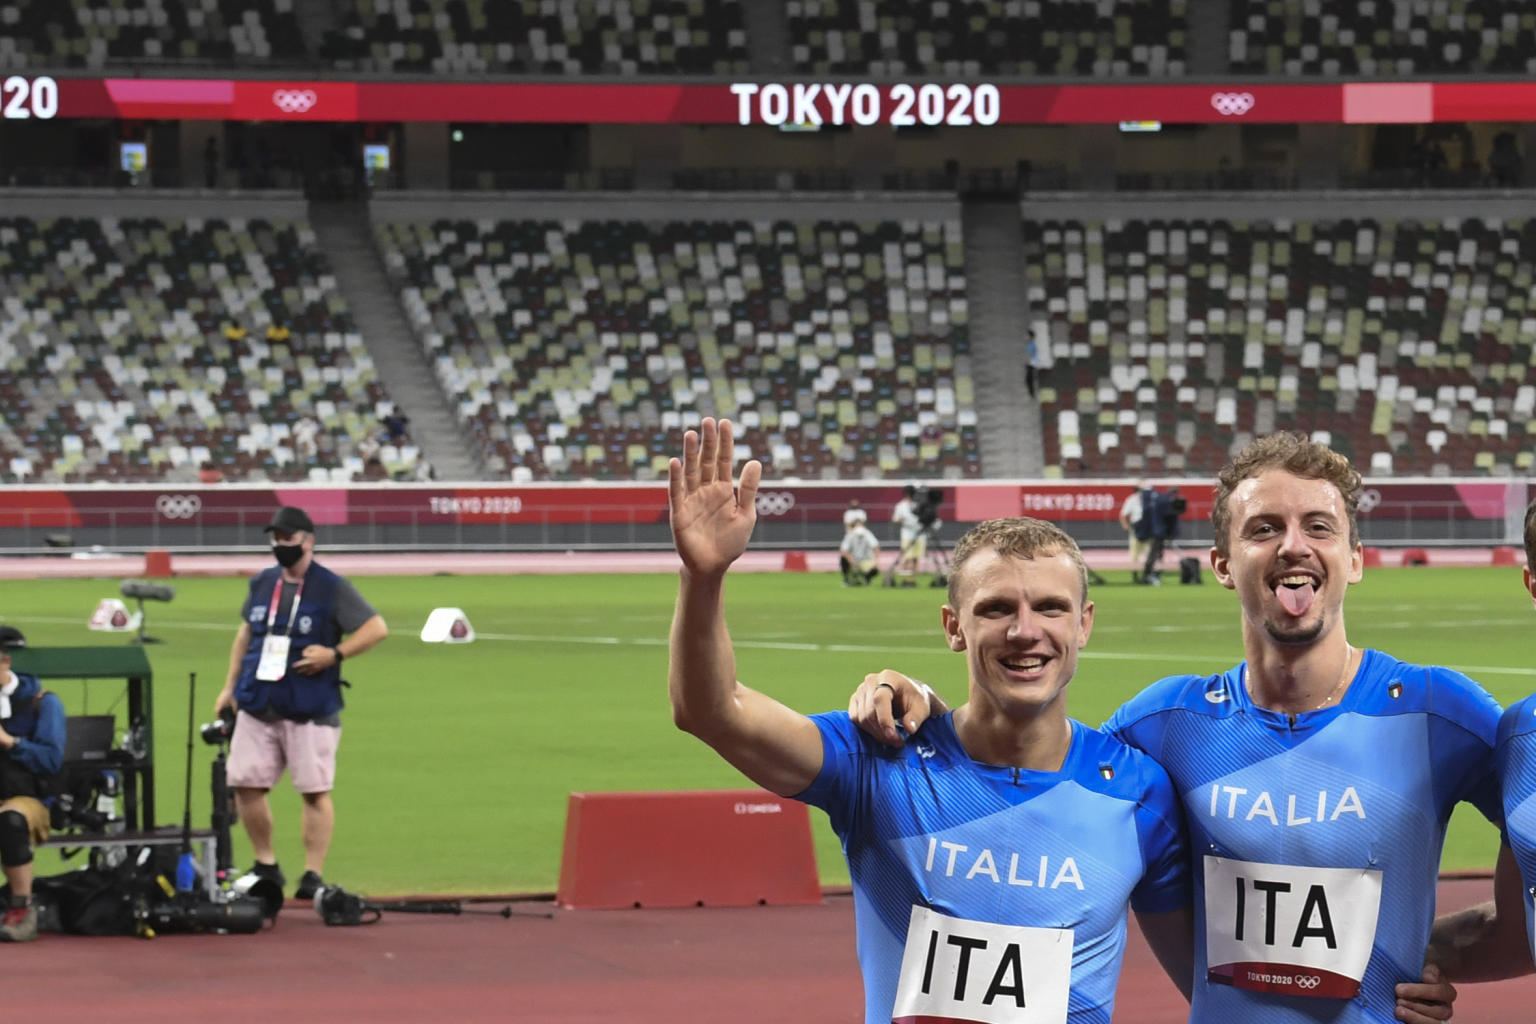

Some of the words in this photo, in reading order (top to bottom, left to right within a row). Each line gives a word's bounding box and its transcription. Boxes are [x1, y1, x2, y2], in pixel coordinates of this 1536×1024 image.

[0, 75, 58, 119] 20
[730, 83, 881, 126] TOKYO
[889, 83, 1000, 126] 2020
[429, 496, 482, 514] TOKYO
[482, 496, 522, 514] 2020
[1023, 493, 1074, 511] TOKYO
[1075, 493, 1114, 511] 2020
[1210, 784, 1367, 827] ITALIA
[925, 837, 1085, 891] ITALIA
[1235, 877, 1337, 949] ITA
[921, 929, 1026, 1008] ITA
[1247, 971, 1271, 983] TOKYO
[1272, 975, 1293, 985] 2020
